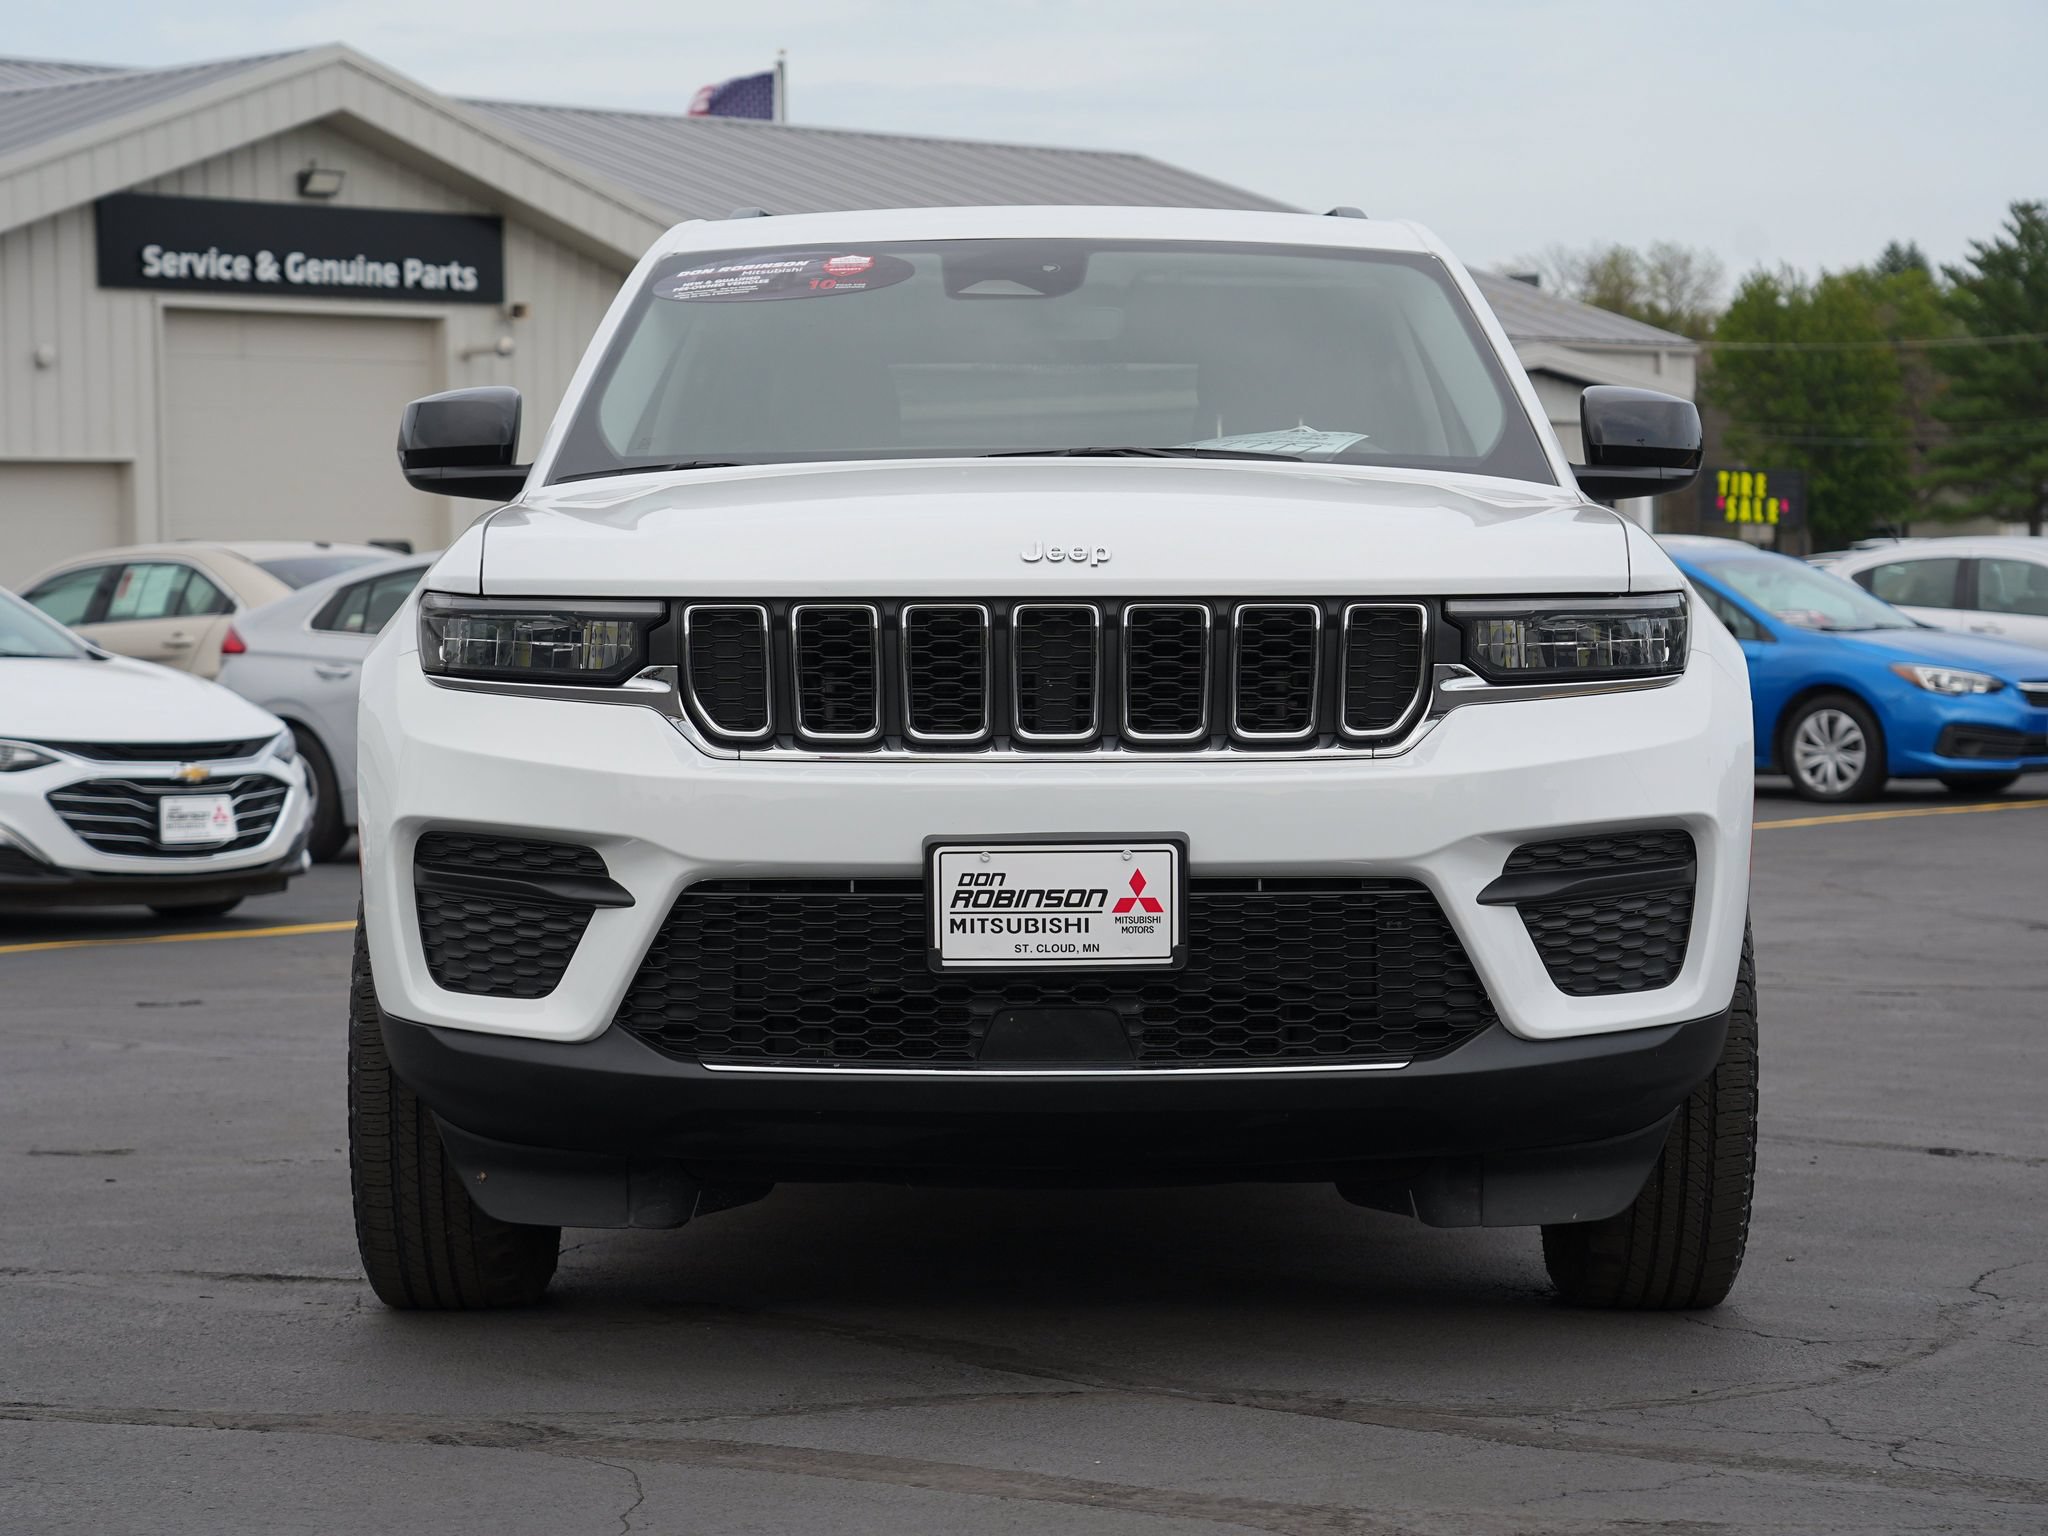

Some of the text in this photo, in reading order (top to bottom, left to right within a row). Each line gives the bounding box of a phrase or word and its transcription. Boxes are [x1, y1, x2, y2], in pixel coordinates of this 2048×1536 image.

[142, 244, 479, 292] Service & Genuine Parts
[676, 260, 810, 277] DON ROBINSON
[741, 267, 803, 276] Mitsubishi
[809, 279, 837, 290] 10
[1716, 470, 1767, 499] TIRE
[1020, 540, 1112, 568] Jeep
[957, 872, 1006, 887] DON
[950, 888, 1109, 909] ROBINSON
[950, 917, 1090, 934] MITSUBISHI
[1114, 915, 1161, 925] MITSUBISHI
[1121, 925, 1155, 935] MOTORS
[1014, 943, 1100, 954] ST. CLOUD, MN
